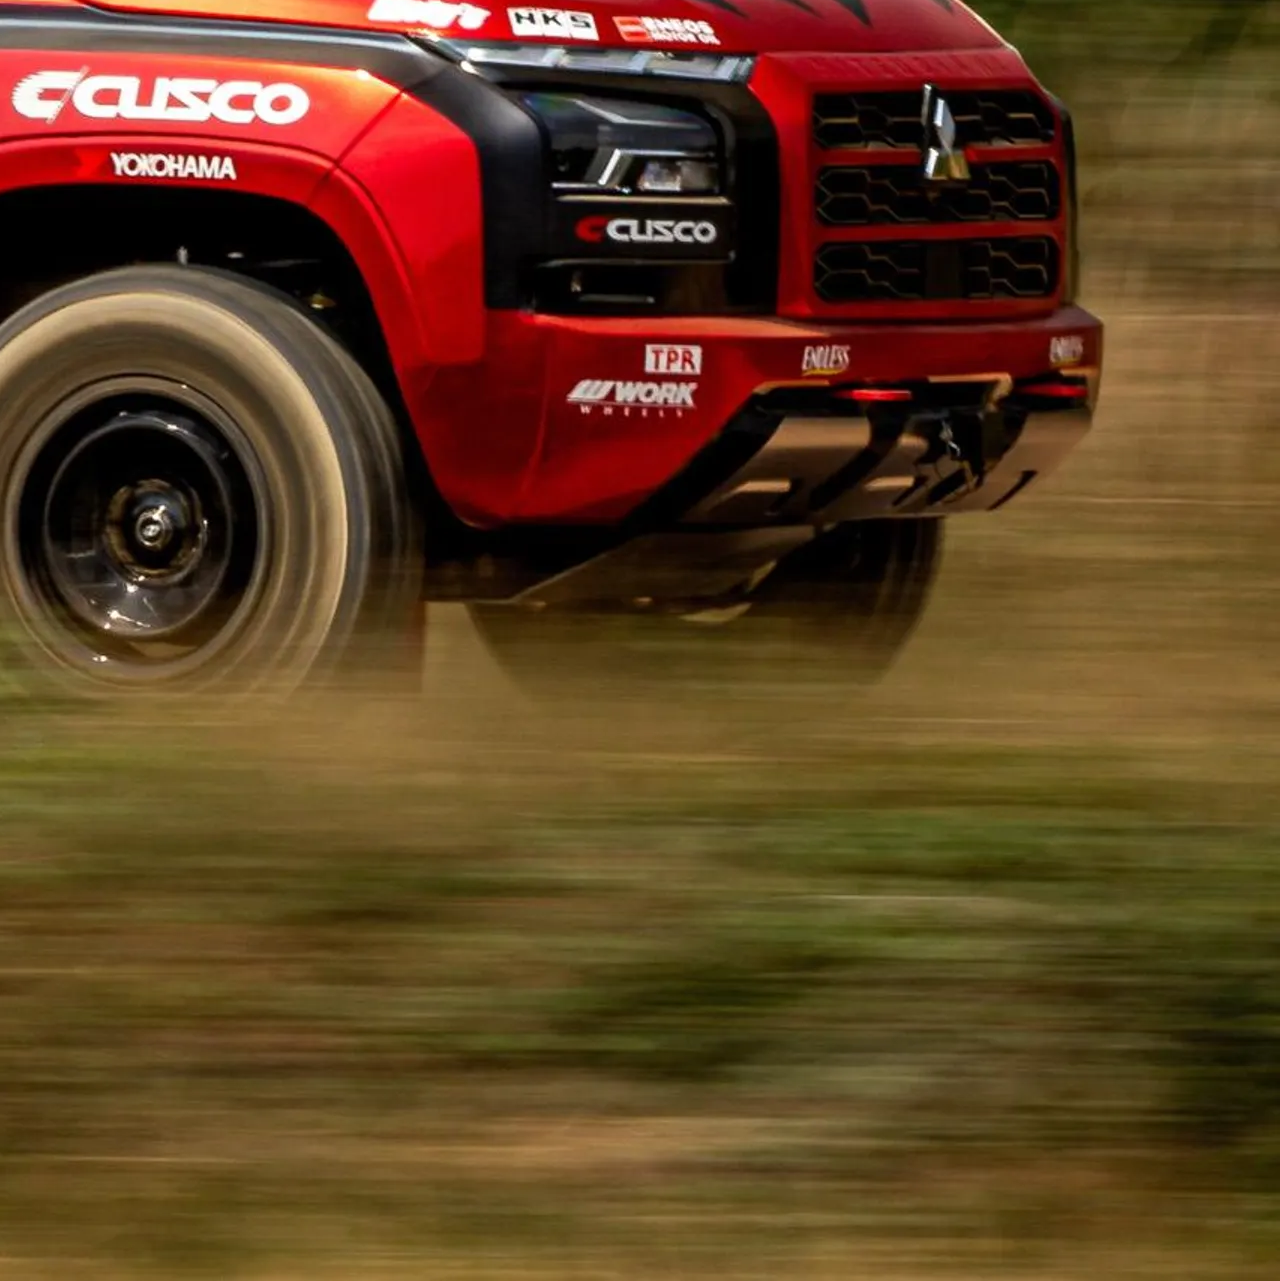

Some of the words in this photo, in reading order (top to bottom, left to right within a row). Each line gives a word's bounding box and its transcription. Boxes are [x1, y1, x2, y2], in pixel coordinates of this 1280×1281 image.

[110, 152, 237, 180] YOKOHAMA
[651, 349, 696, 370] TPR
[613, 380, 699, 407] WORK
